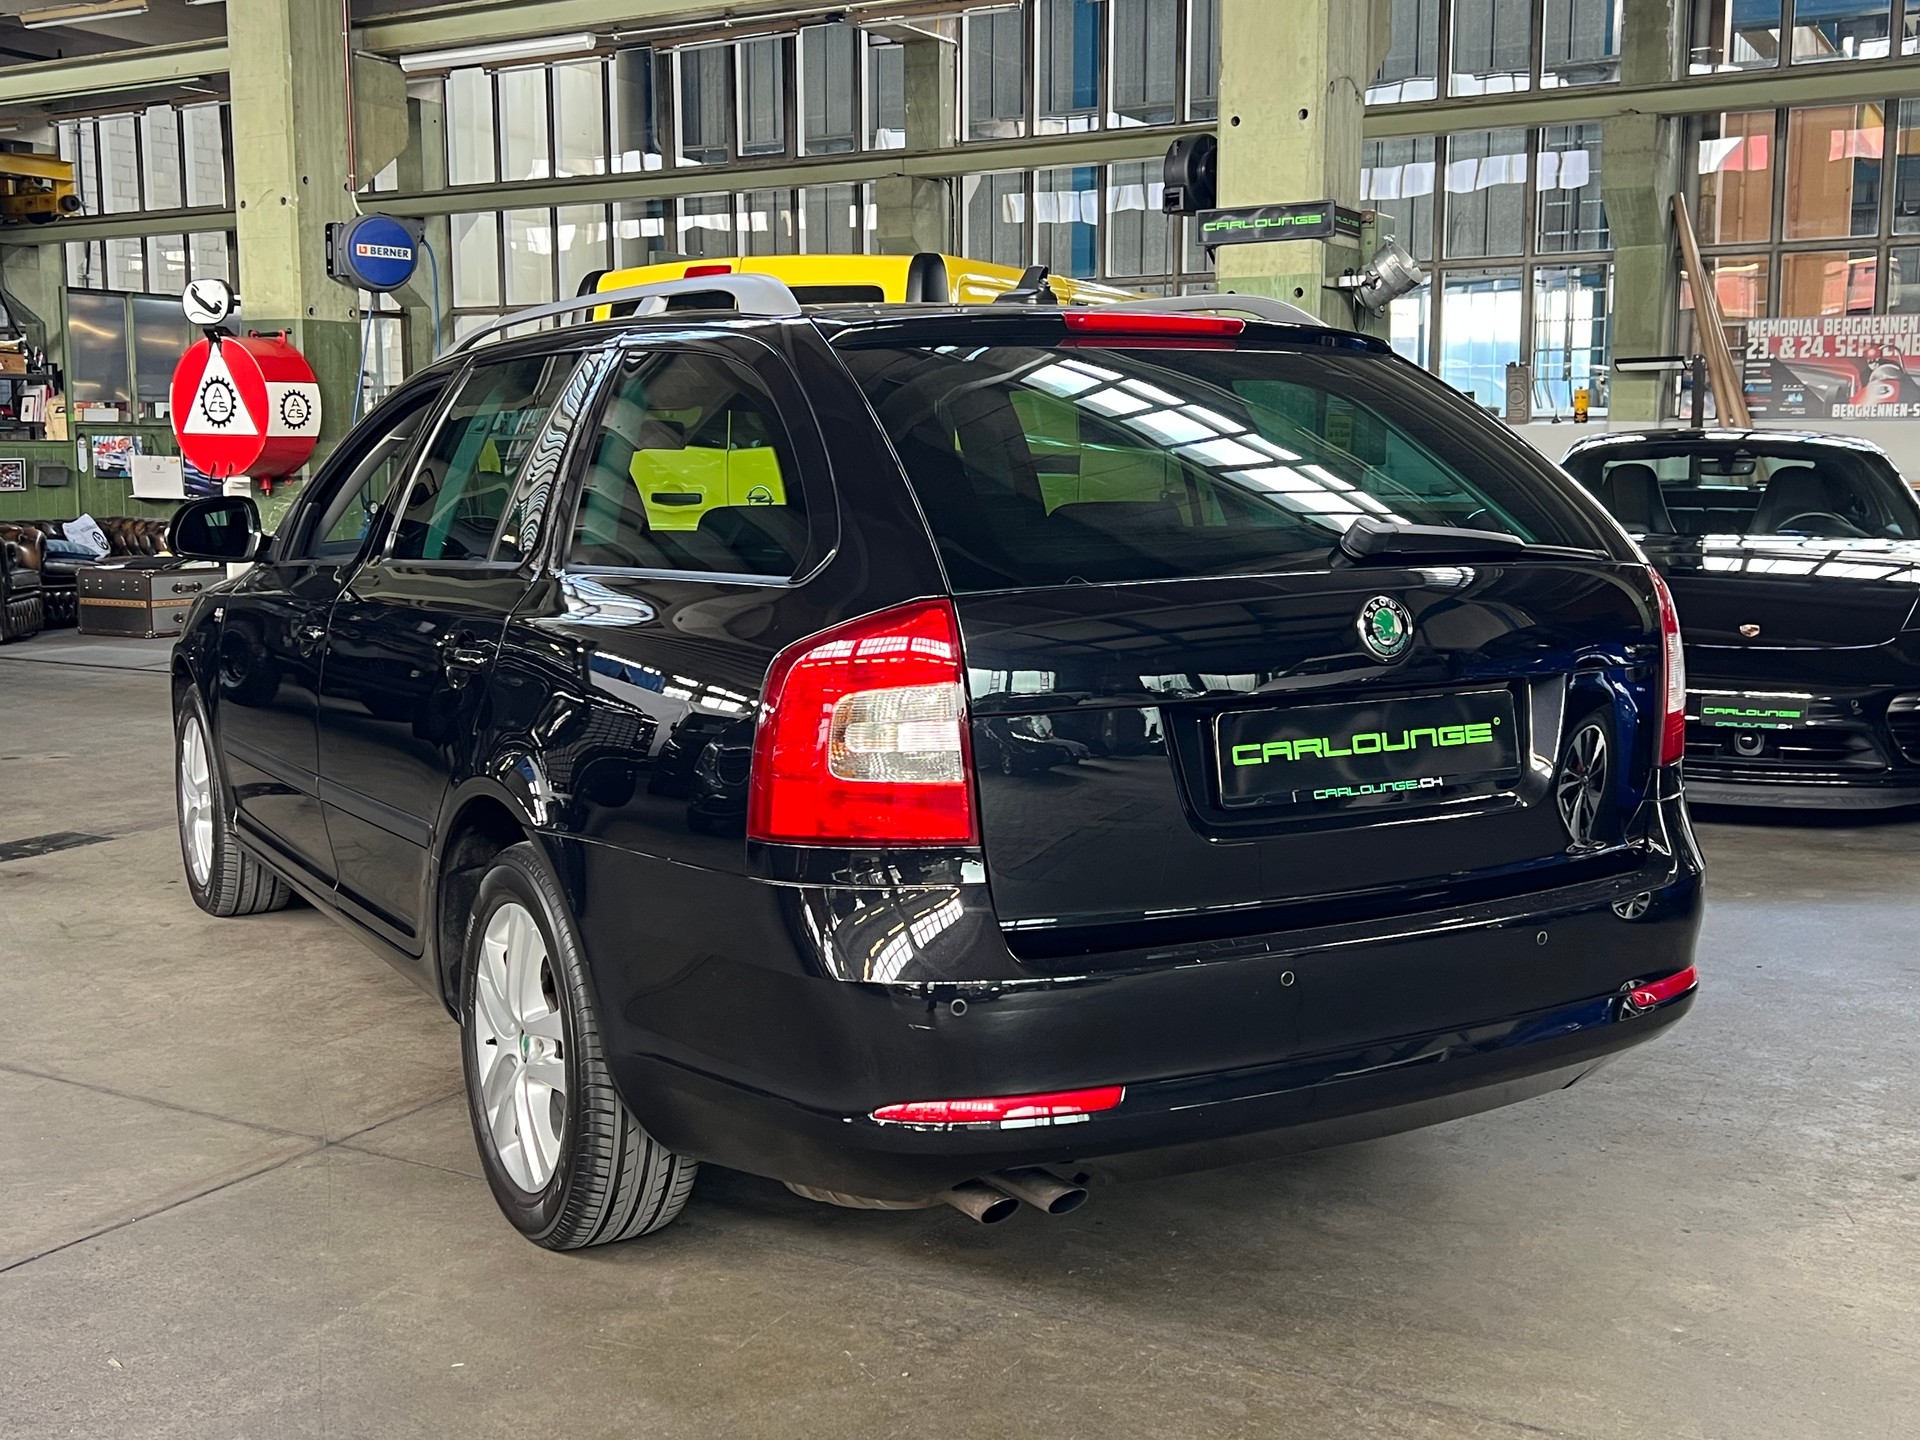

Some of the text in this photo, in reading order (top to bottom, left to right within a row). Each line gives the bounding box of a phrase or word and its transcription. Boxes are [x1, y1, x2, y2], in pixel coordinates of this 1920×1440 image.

[1203, 214, 1322, 232] CARLOUNGE
[370, 246, 409, 258] BERNER
[1747, 316, 1918, 338] MEMORIAL BERGRENNEN
[1746, 337, 1775, 360] 23.
[1779, 336, 1796, 359] &
[1799, 335, 1830, 358] 24.
[212, 387, 223, 399] A
[208, 401, 228, 413] CS
[290, 397, 300, 408] A
[1831, 403, 1920, 418] BERGRENNEN-S
[1703, 707, 1801, 718] CARLOUNGE
[1232, 722, 1494, 766] CARLOUNGE
[1313, 776, 1443, 800] CARLOUNGE.CH
